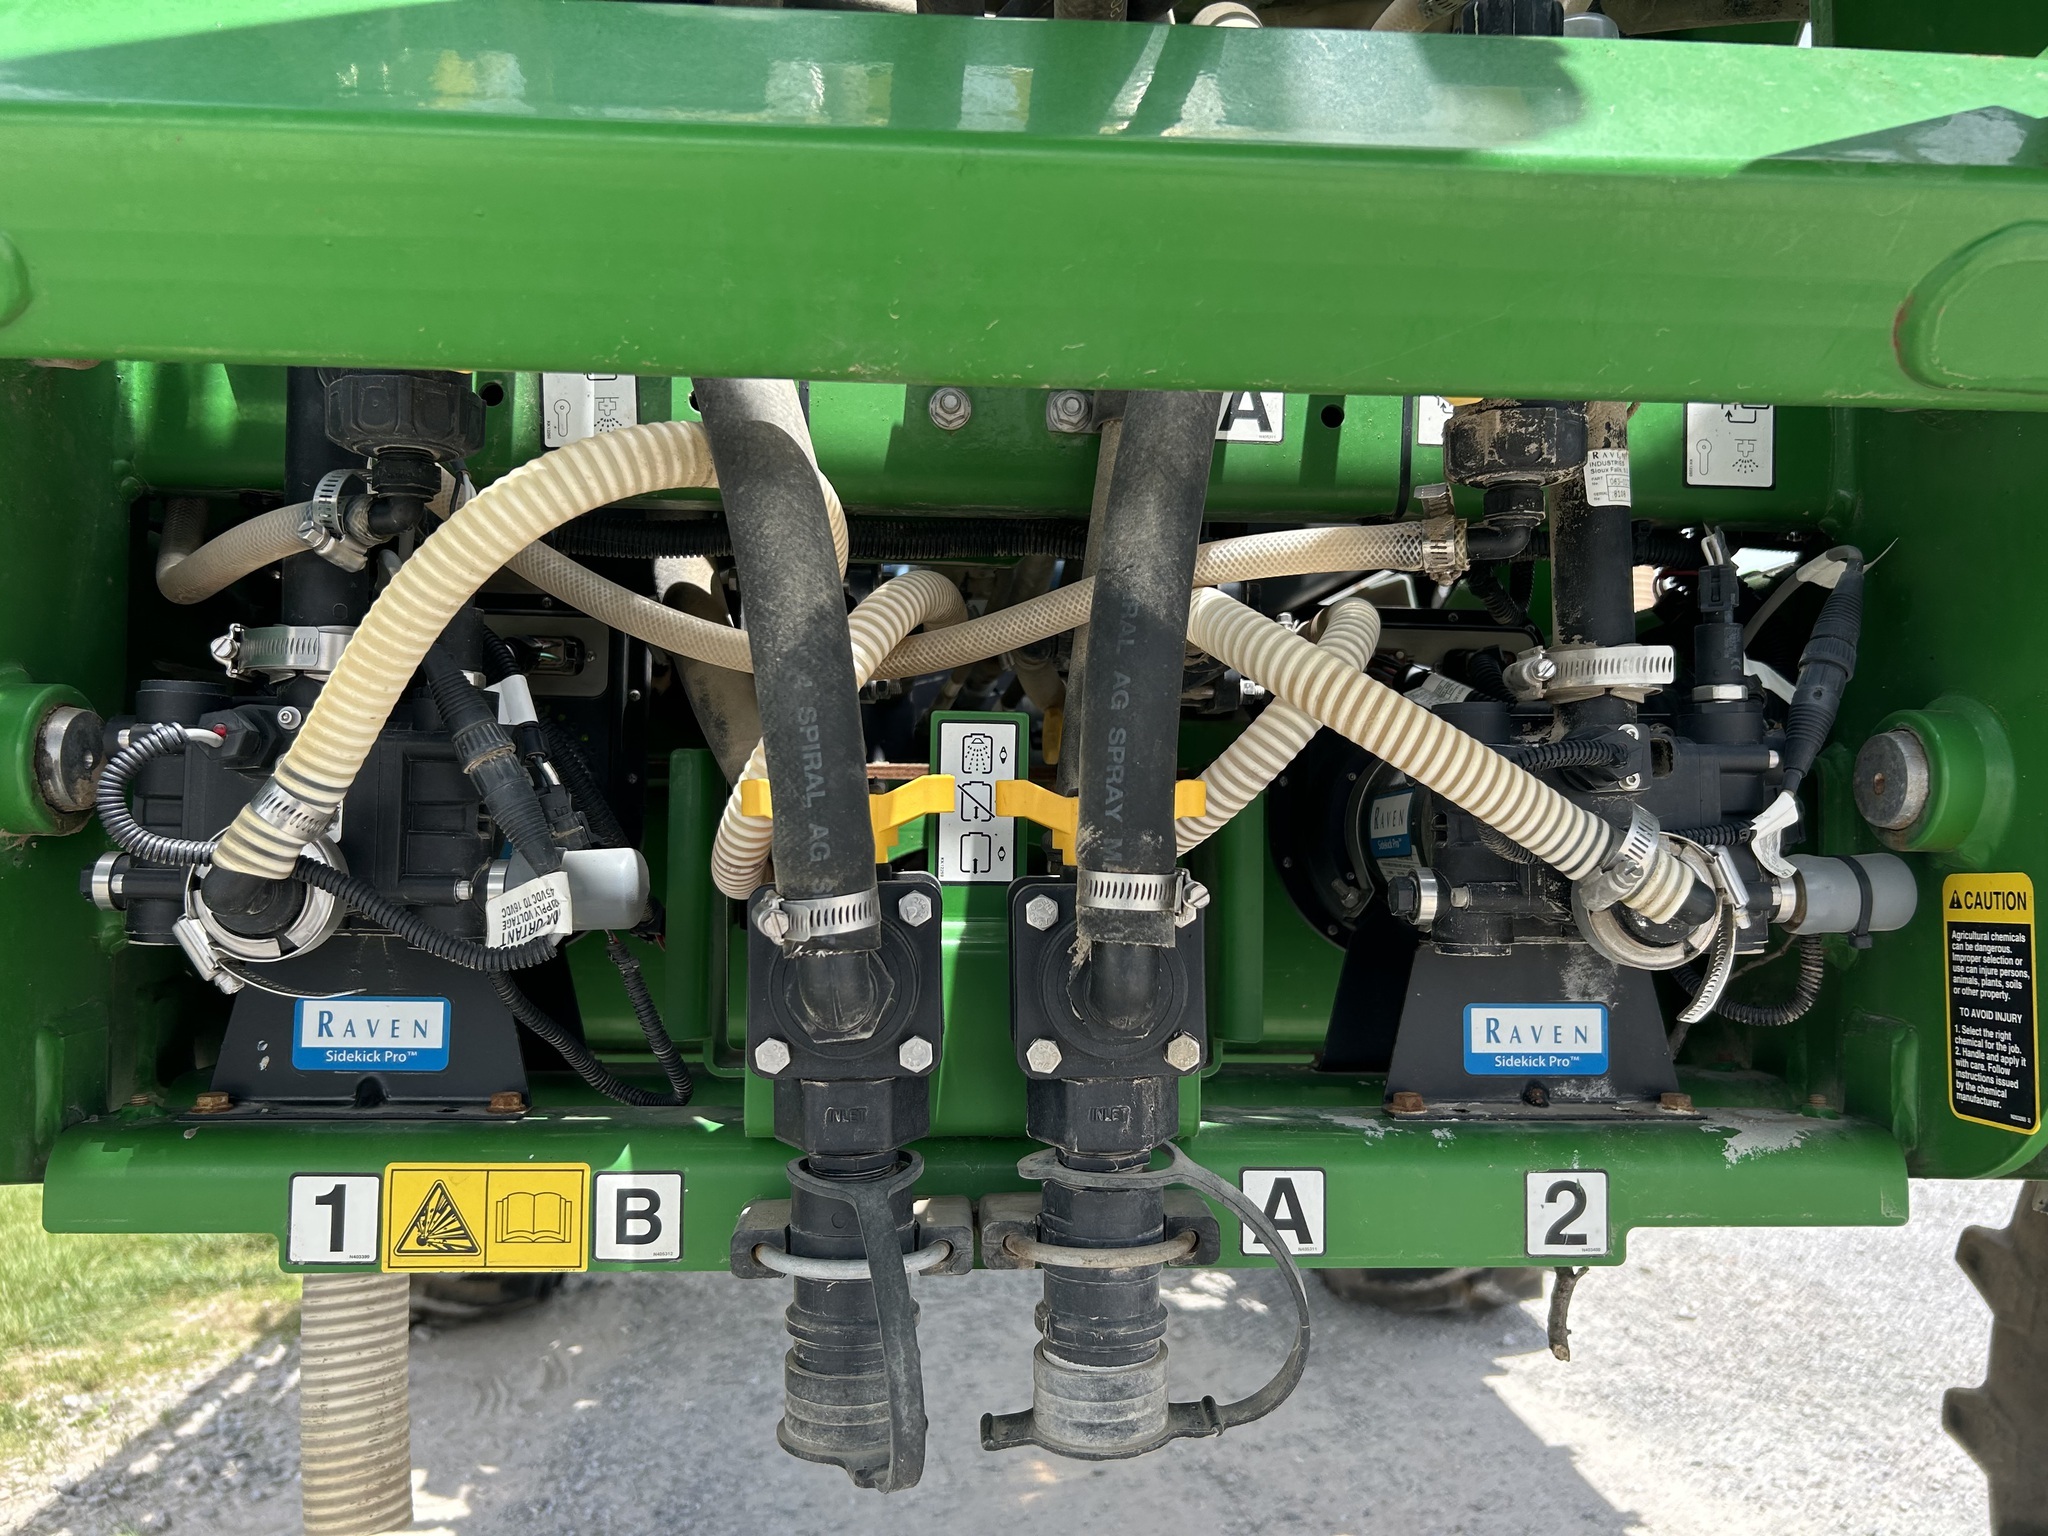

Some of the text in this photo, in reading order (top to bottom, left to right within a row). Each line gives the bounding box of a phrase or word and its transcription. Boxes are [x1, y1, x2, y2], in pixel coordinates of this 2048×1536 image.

[1218, 392, 1272, 432] A
[1111, 670, 1131, 710] AG
[799, 706, 826, 808] SPIRAL
[1105, 726, 1126, 822] SPRAY
[1374, 806, 1404, 830] RAVEN
[808, 823, 832, 862] AG
[523, 897, 532, 908] TO
[1964, 891, 2026, 910] CAUTION
[502, 902, 521, 918] 16VDC
[502, 911, 534, 930] VOLTAGE
[1952, 930, 2026, 942] Agricultural chemicals
[1965, 942, 1973, 951] be
[1975, 943, 2012, 954] dangerous.
[1952, 952, 1981, 964] Improper
[1983, 955, 2013, 965] selection
[1979, 965, 1998, 977] injure
[2000, 969, 2030, 980] persons,
[1953, 975, 2022, 989] animals, plants, soils
[1962, 987, 1979, 996] other
[1980, 989, 2010, 1002] property.
[318, 1011, 428, 1038] RAVEN
[1959, 1007, 2022, 1024] TO AVOID INJURY
[1486, 1018, 1587, 1044] RAVEN
[1955, 1024, 2011, 1042] 1. Select the right
[1955, 1036, 2022, 1055] chemical for the job.
[326, 1050, 381, 1062] Sidekick
[1494, 1056, 1546, 1067] Sidekick
[1955, 1046, 2026, 1068] 2. Handle and apply it
[1955, 1058, 2010, 1076] with care. Follow
[1956, 1068, 2019, 1089] instructions issued
[1956, 1080, 2007, 1098] by the chemical
[1956, 1092, 2002, 1109] manufacturer.
[830, 1108, 867, 1121] INLET
[1089, 1107, 1129, 1121] INLET
[315, 1184, 347, 1252] 1
[616, 1188, 662, 1245] B
[1253, 1177, 1313, 1244] A
[1545, 1180, 1587, 1245] 2
